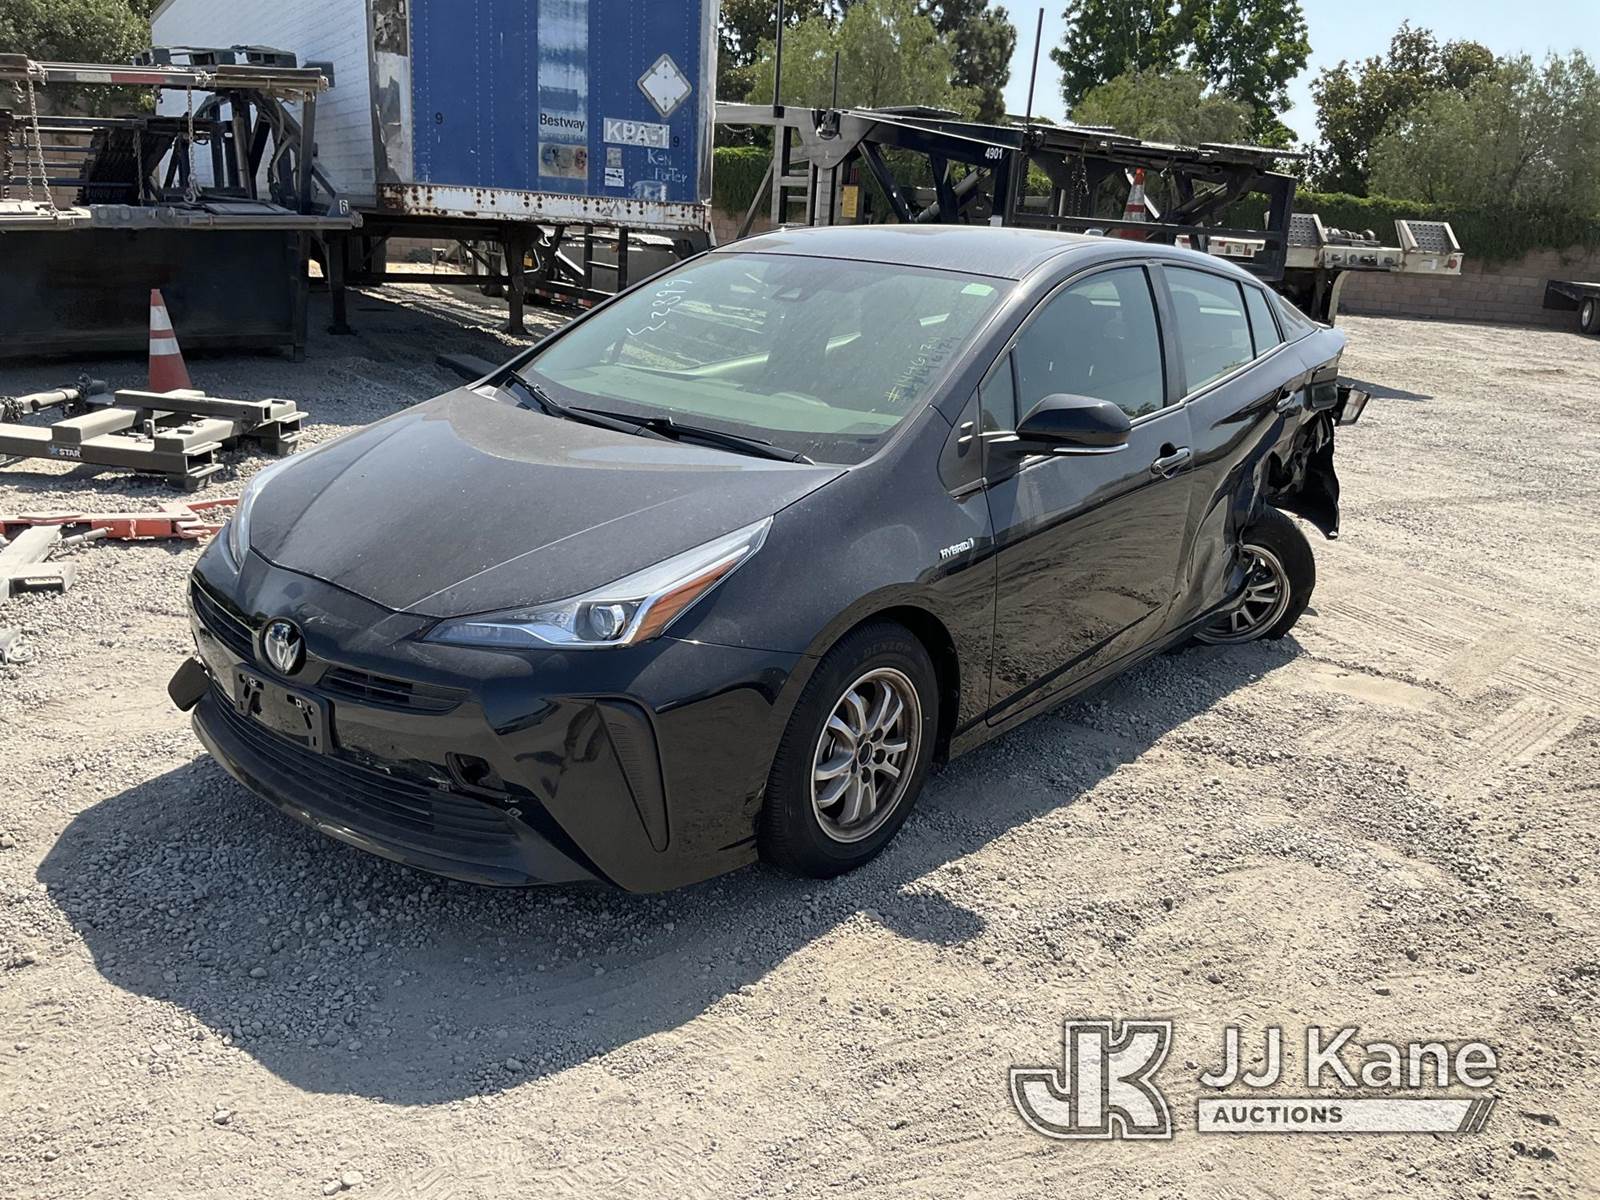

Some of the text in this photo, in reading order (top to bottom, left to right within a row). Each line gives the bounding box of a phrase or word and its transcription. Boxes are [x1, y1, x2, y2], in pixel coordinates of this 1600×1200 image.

[435, 112, 443, 125] 9
[540, 113, 585, 132] Bestway
[673, 136, 680, 147] 9
[985, 147, 1003, 159] 4901
[59, 448, 81, 458] STAR
[940, 540, 971, 559] HYBRID
